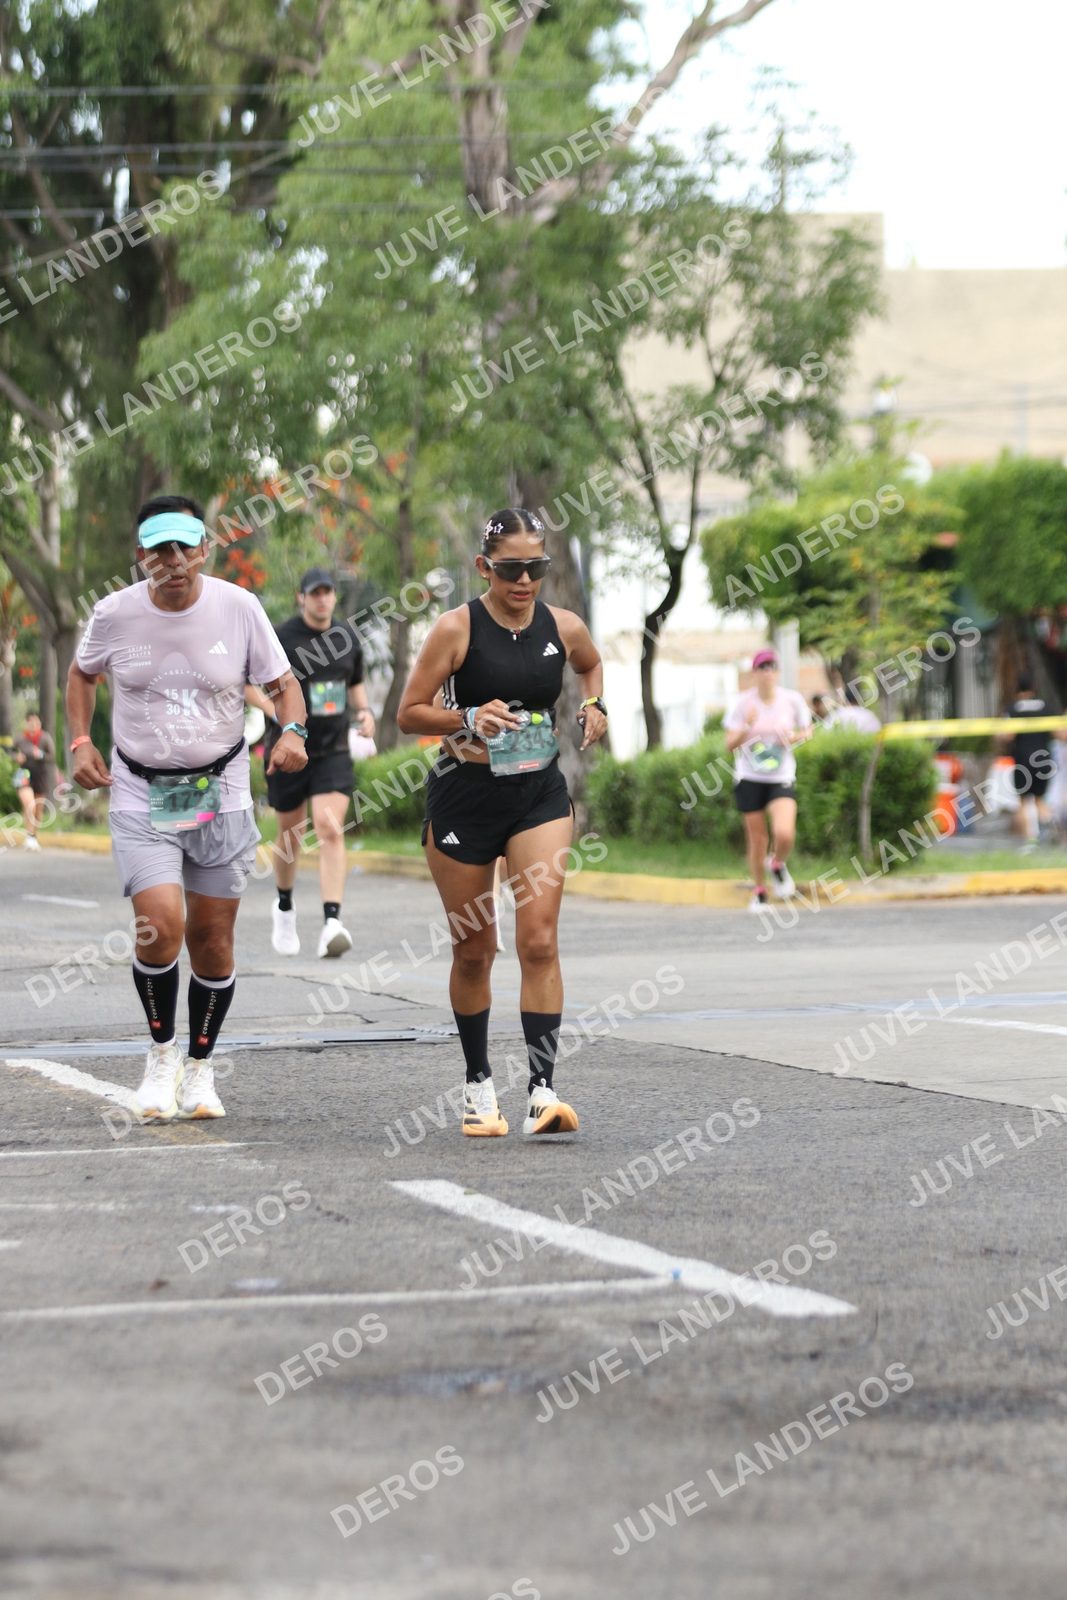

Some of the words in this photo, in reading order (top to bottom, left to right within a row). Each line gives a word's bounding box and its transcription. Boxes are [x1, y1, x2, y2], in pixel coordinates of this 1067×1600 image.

[164, 688, 179, 701] 15
[182, 688, 202, 721] K
[166, 703, 180, 716] 30
